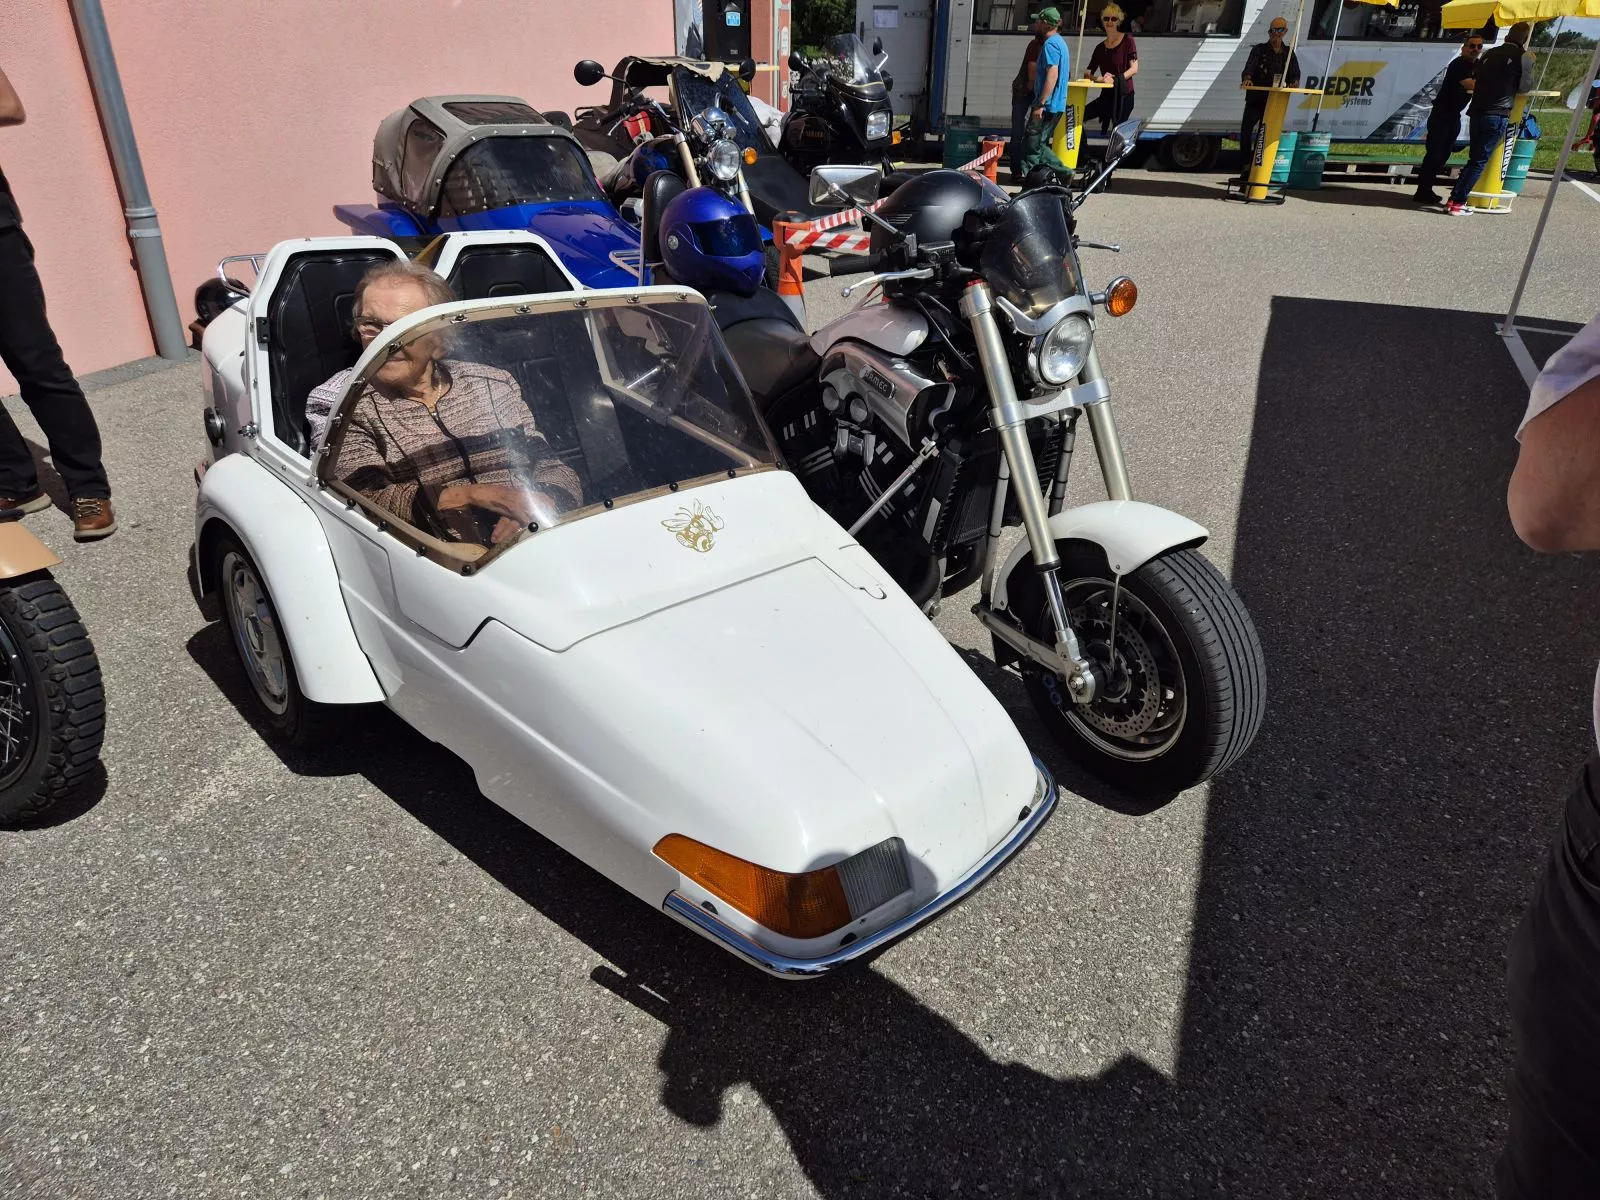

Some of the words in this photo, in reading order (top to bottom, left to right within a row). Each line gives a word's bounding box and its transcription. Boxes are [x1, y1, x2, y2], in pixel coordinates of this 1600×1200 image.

[1341, 95, 1372, 107] Systems
[1255, 125, 1266, 164] CARDINAL
[1501, 125, 1516, 178] CARDINAL
